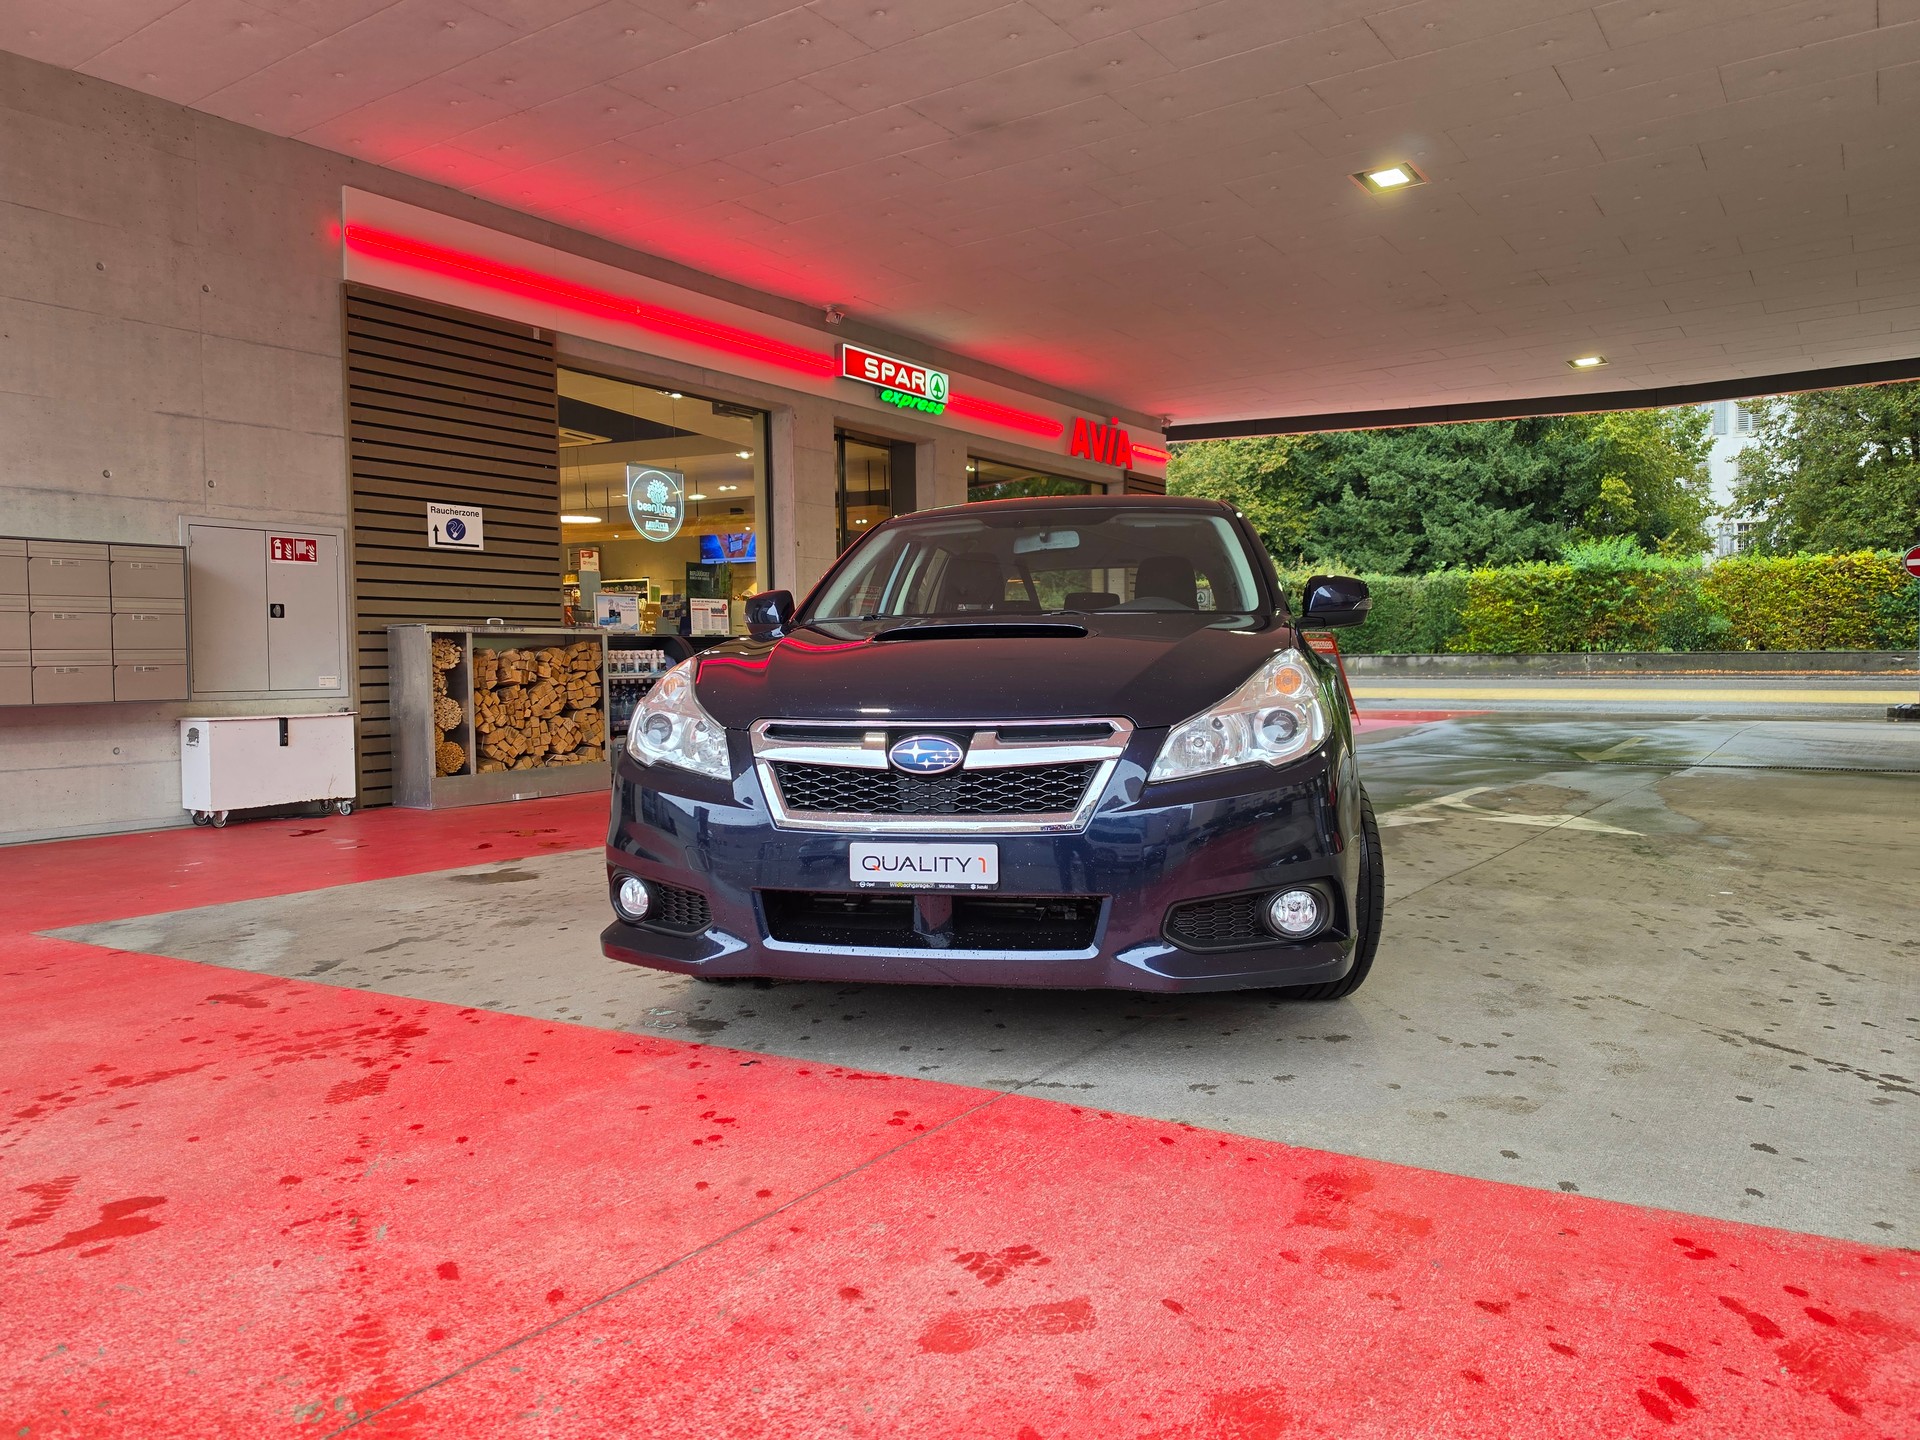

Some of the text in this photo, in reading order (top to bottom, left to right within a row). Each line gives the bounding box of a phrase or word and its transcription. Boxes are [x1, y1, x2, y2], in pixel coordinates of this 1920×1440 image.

[864, 357, 925, 392] SPAR
[880, 389, 945, 416] express
[430, 505, 480, 518] Raucherzone
[636, 499, 657, 512] bean
[660, 503, 676, 514] tree
[862, 855, 986, 873] QUALITY 1
